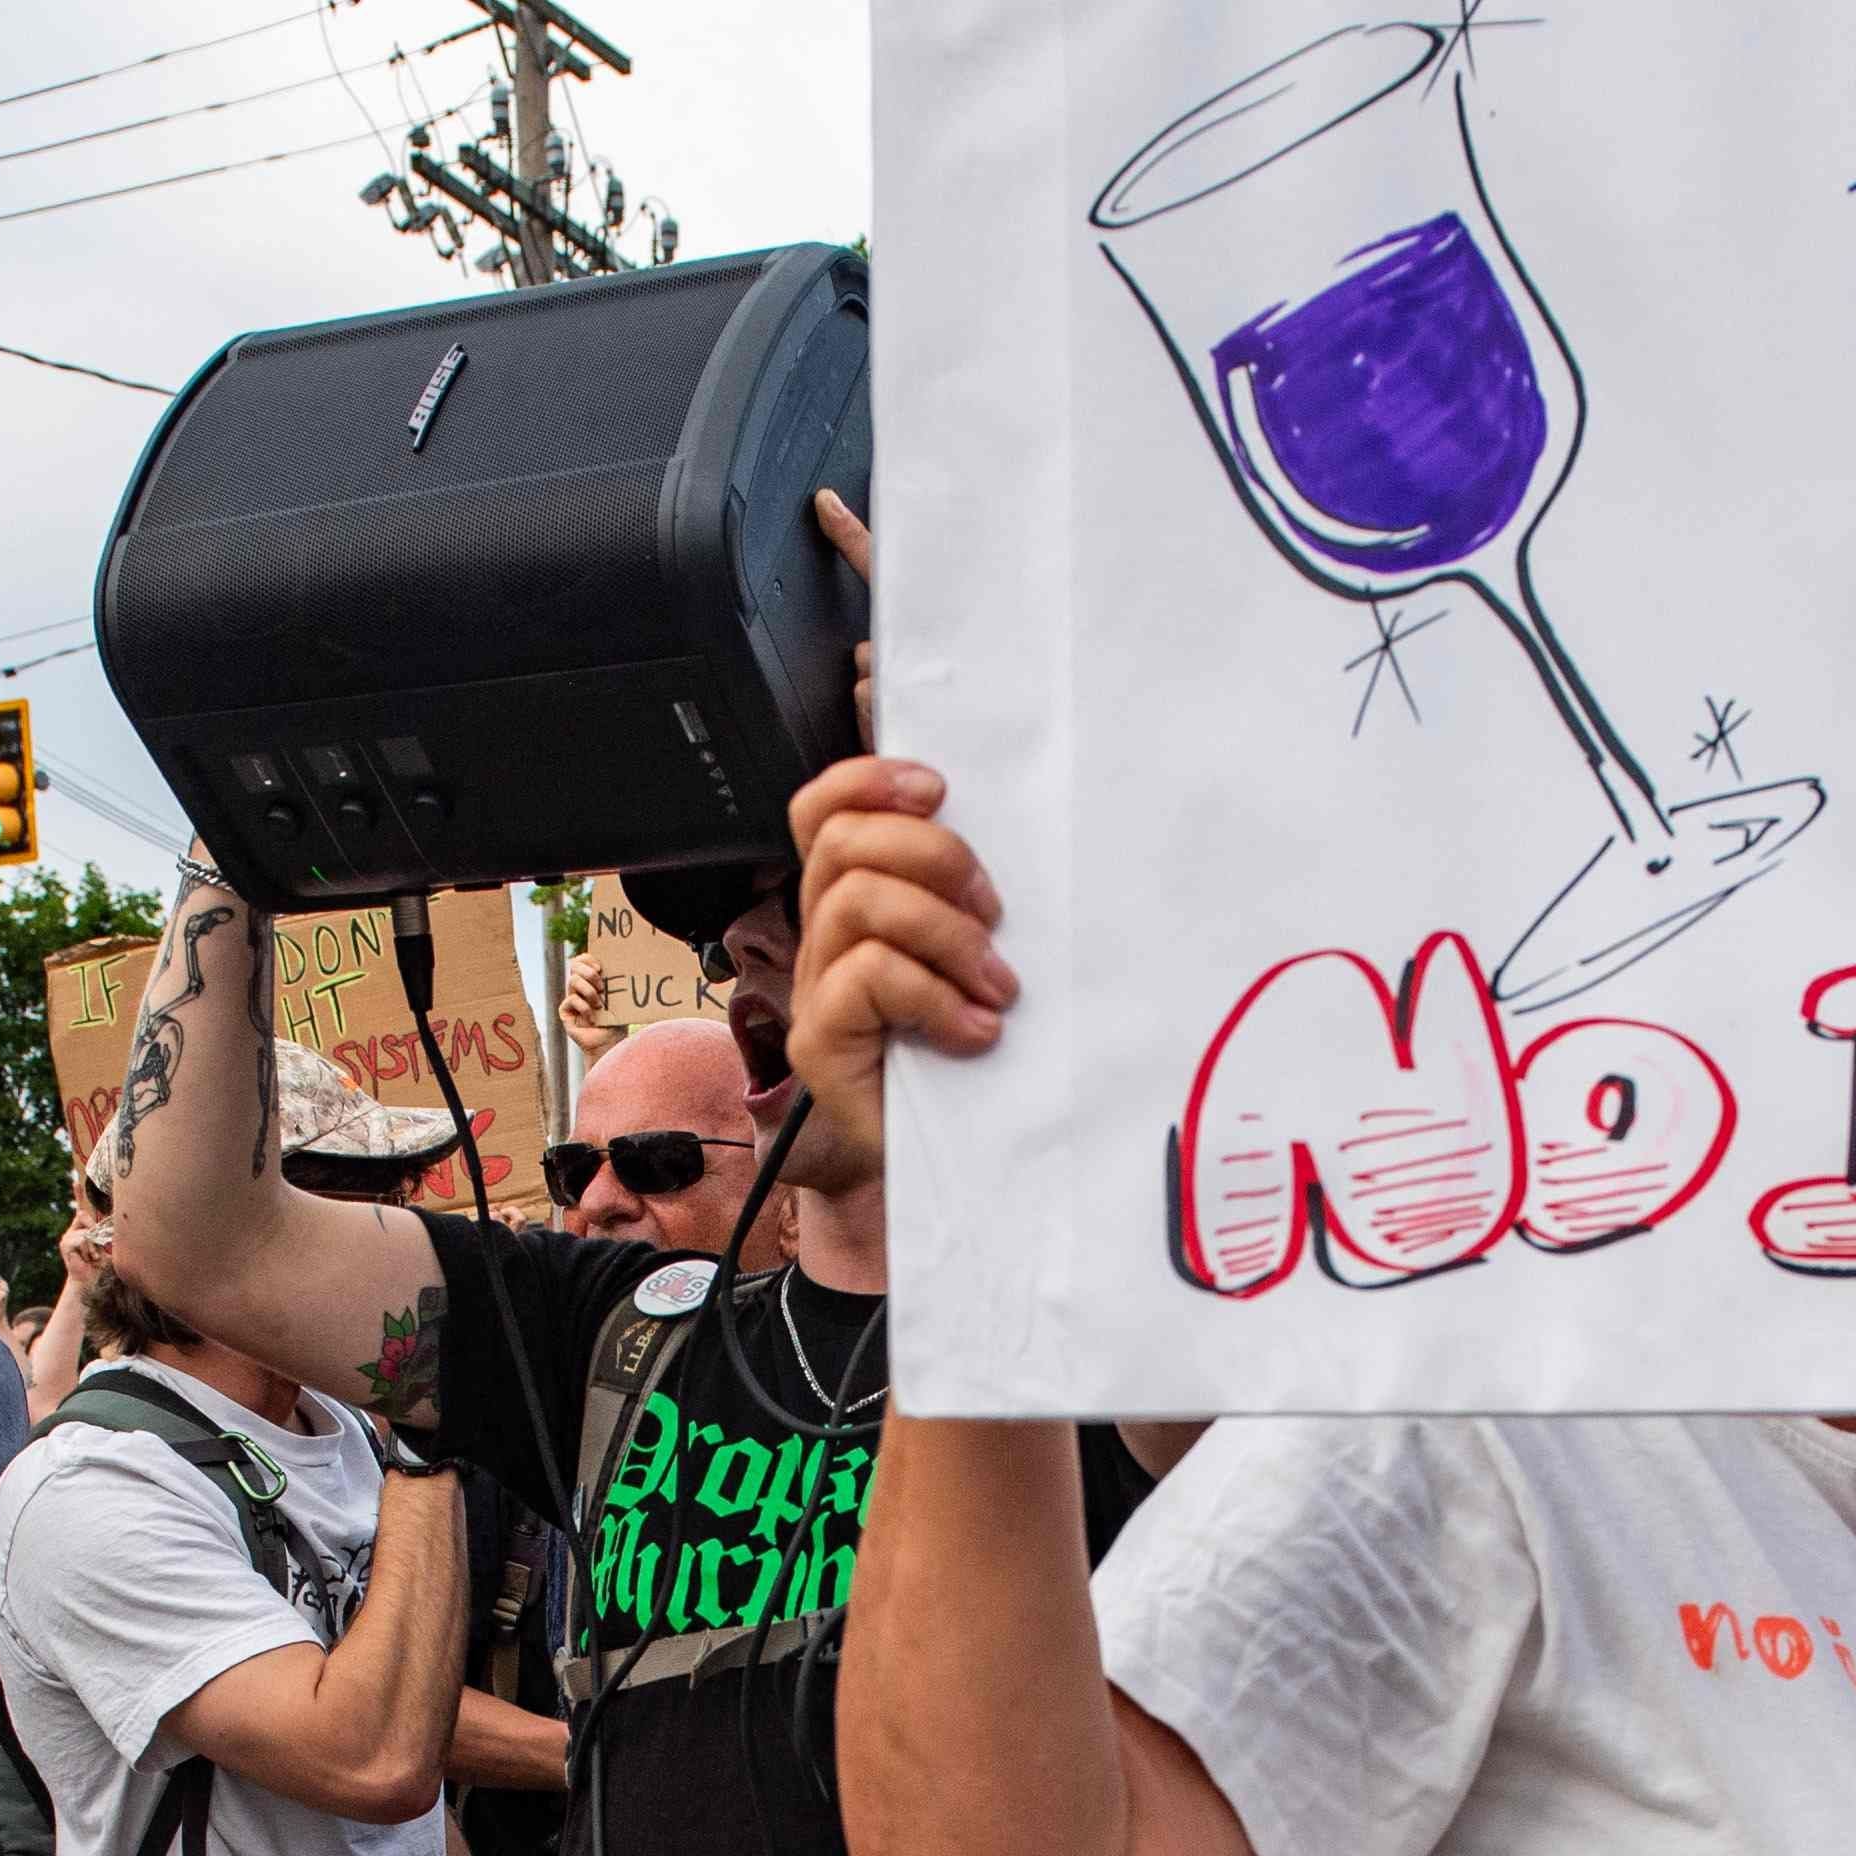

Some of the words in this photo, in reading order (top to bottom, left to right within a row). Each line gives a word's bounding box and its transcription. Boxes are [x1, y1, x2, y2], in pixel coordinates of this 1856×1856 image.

[407, 341, 467, 449] BOSE
[597, 907, 634, 939] NO
[67, 952, 130, 1029] IF
[601, 972, 728, 1011] FUCK
